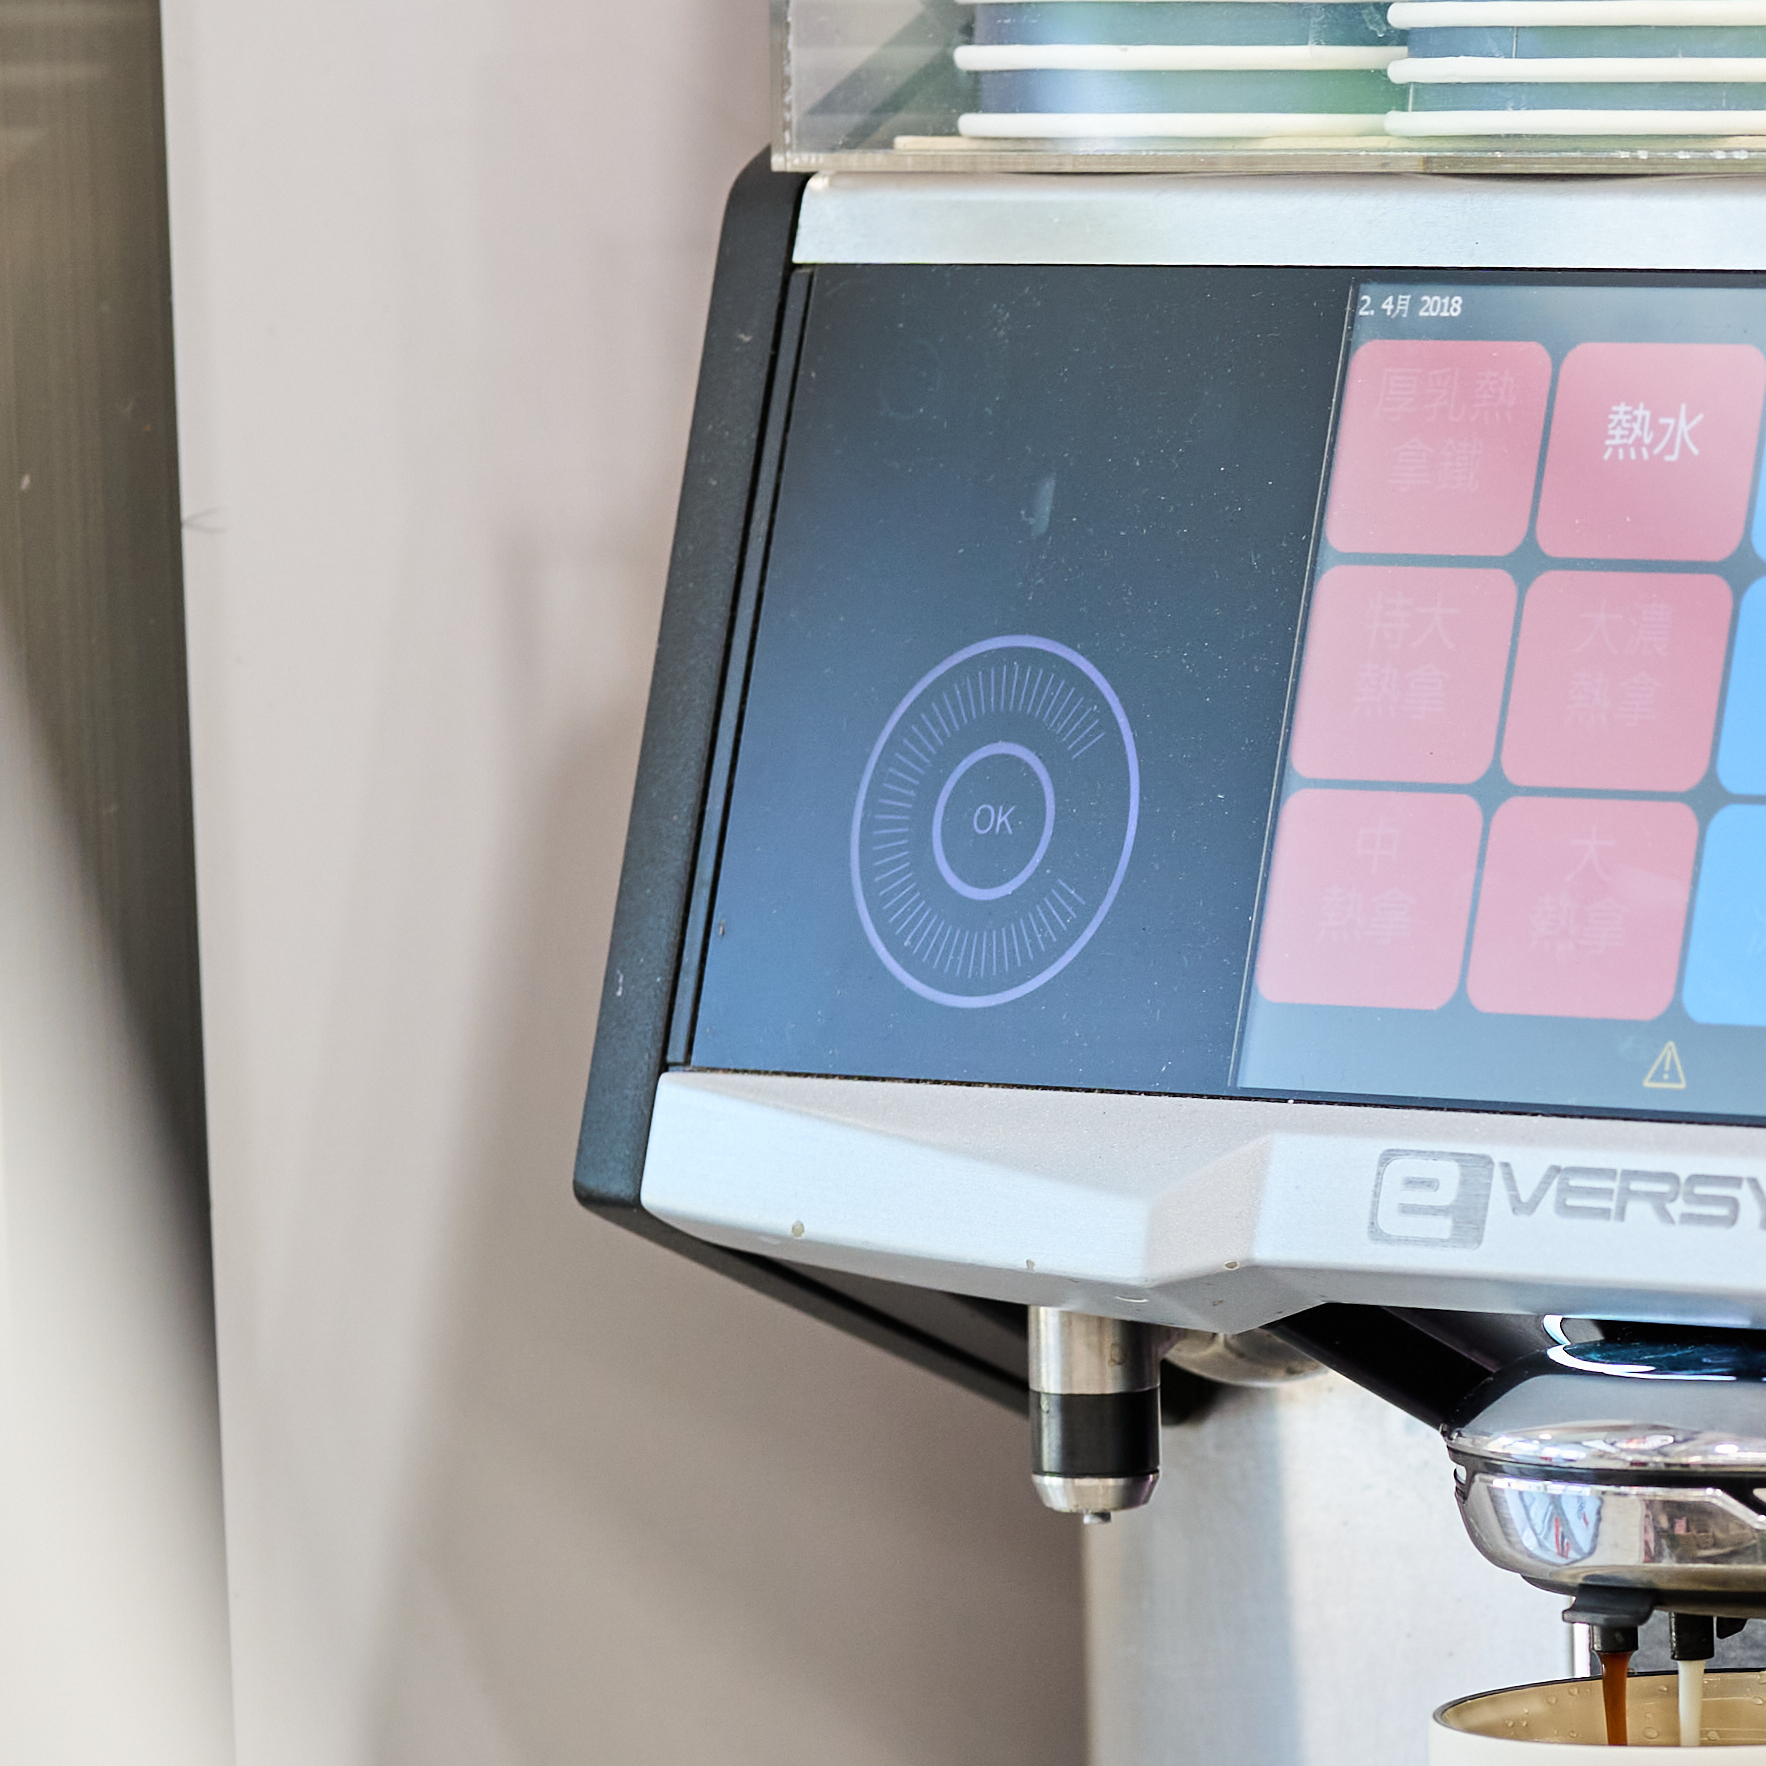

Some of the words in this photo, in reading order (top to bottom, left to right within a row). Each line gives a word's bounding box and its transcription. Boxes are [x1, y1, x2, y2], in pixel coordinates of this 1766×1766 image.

[1358, 295, 1375, 316] 2.
[1381, 294, 1411, 318] 4月
[1418, 295, 1463, 317] 2018
[1602, 402, 1705, 462] 熱水
[1386, 436, 1483, 494] 拿鐵
[1365, 591, 1461, 651] 特大
[1572, 597, 1676, 658] 大濃
[1350, 663, 1452, 721] 熱拿
[973, 803, 1015, 835] OK
[1356, 816, 1401, 875] 中
[1564, 823, 1617, 884] 大
[1316, 884, 1417, 946] 熱拿
